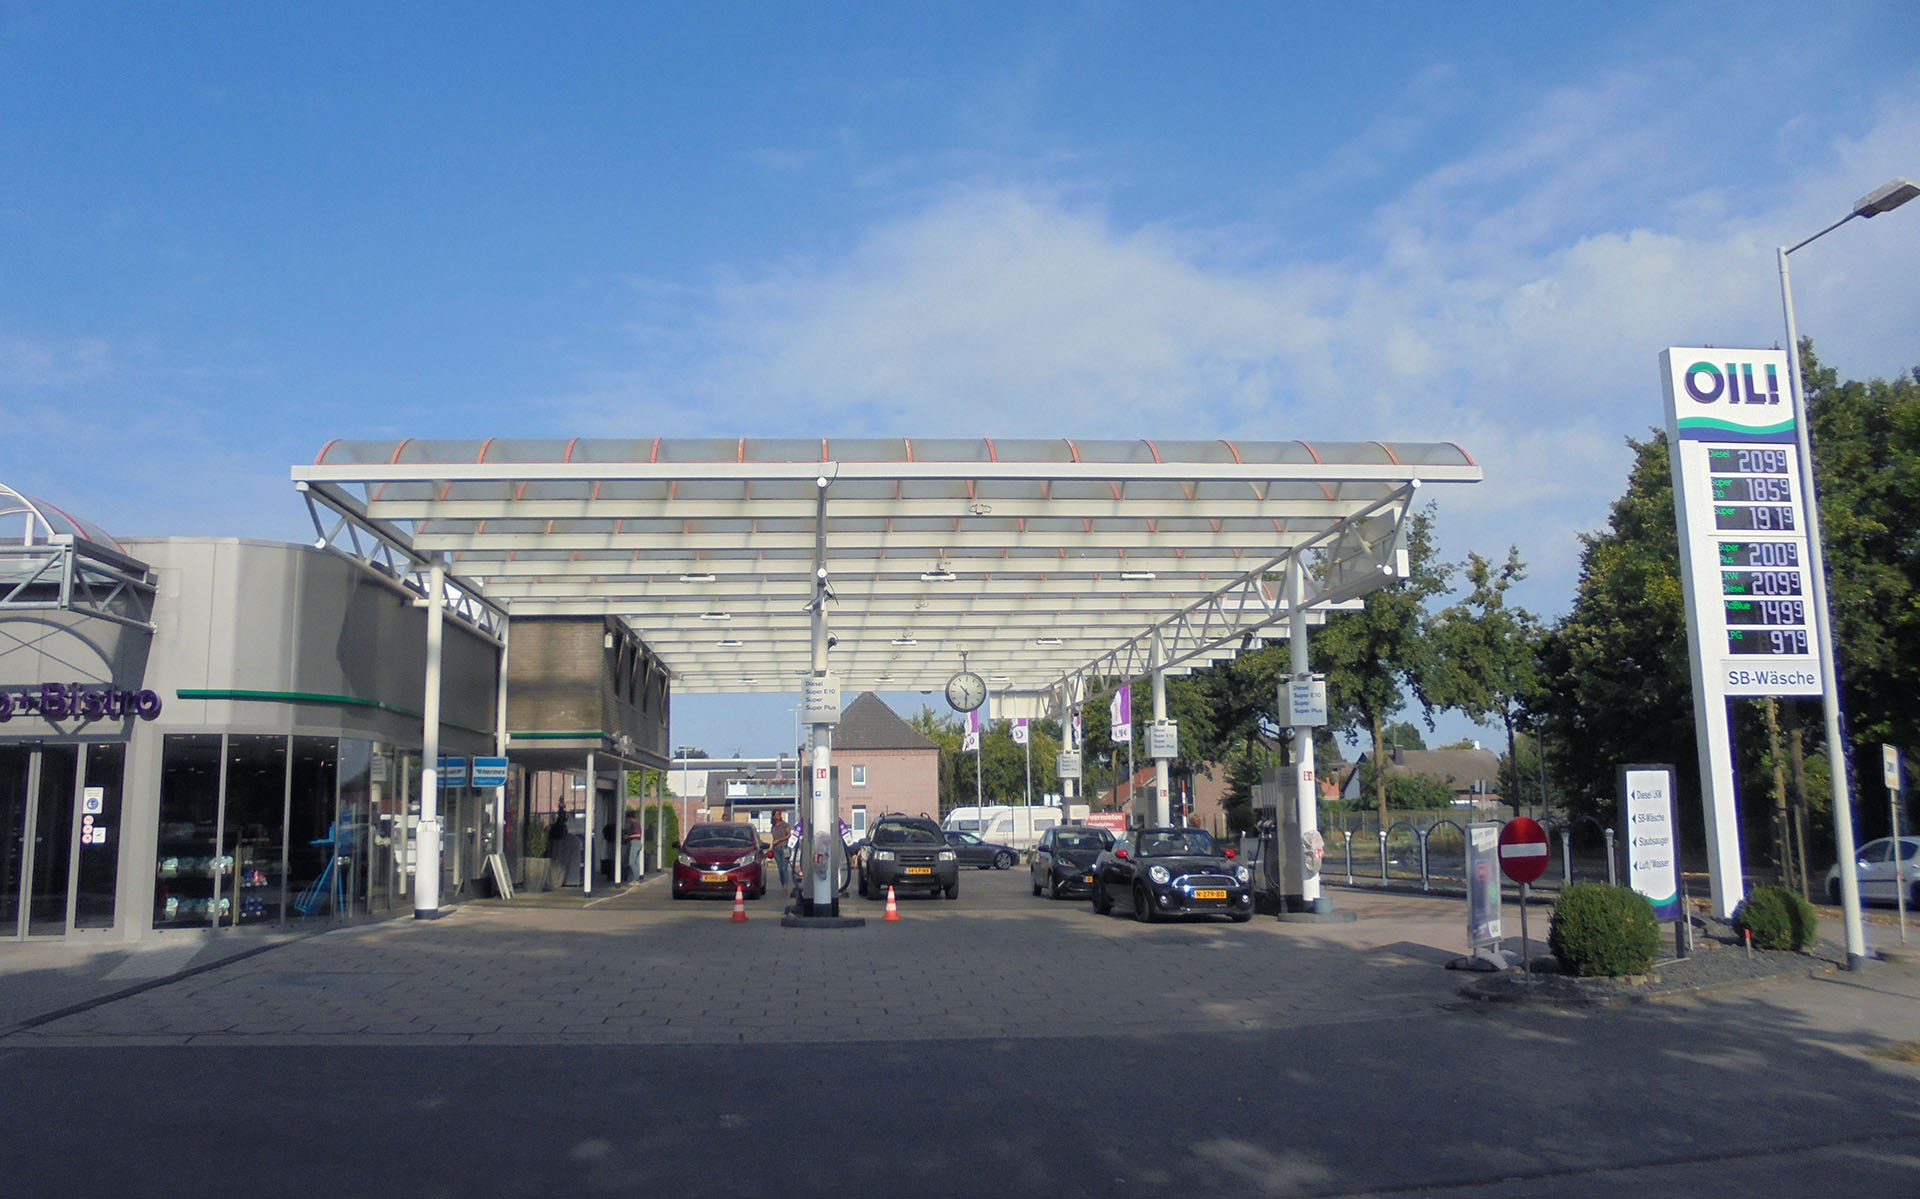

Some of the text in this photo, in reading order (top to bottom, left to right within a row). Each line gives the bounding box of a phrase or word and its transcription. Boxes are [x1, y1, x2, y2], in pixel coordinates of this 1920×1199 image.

[1684, 361, 1780, 405] OIL!
[1737, 450, 1786, 473] 2099
[1746, 478, 1789, 502] 1859
[1748, 543, 1797, 566] 2009
[1751, 572, 1800, 595] 2099
[1760, 601, 1803, 625] 1499
[1770, 630, 1807, 654] 979
[1728, 670, 1815, 685] SB-Wäsche
